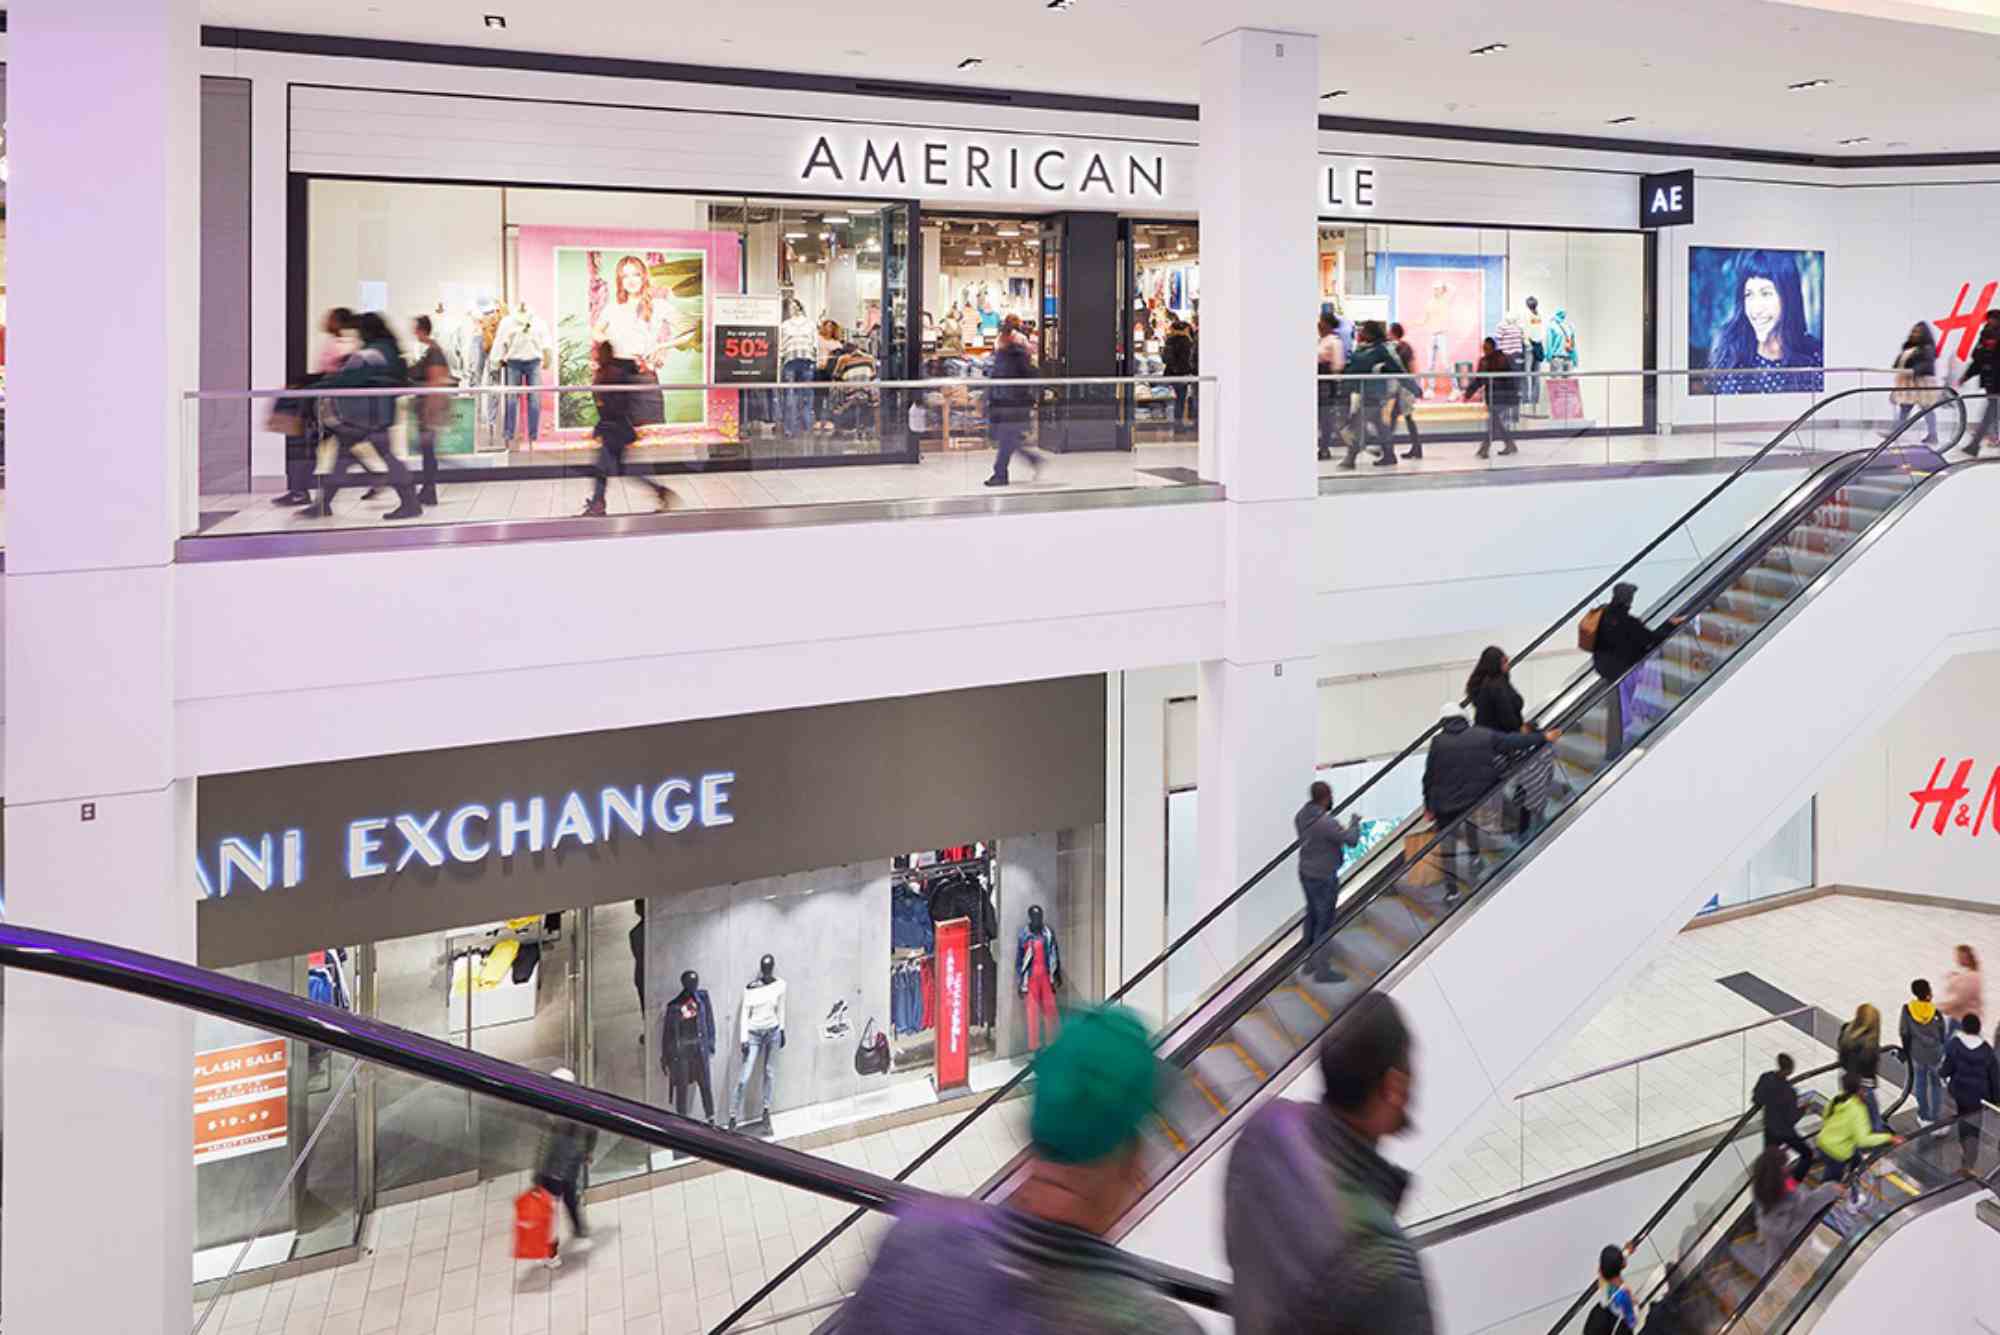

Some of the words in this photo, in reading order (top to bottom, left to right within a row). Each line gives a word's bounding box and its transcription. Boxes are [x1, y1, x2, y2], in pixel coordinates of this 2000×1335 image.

[801, 136, 1163, 196] AMERICAN
[1651, 185, 1683, 213] AE
[348, 771, 735, 879] EXCHANGE
[246, 1050, 284, 1067] SALE
